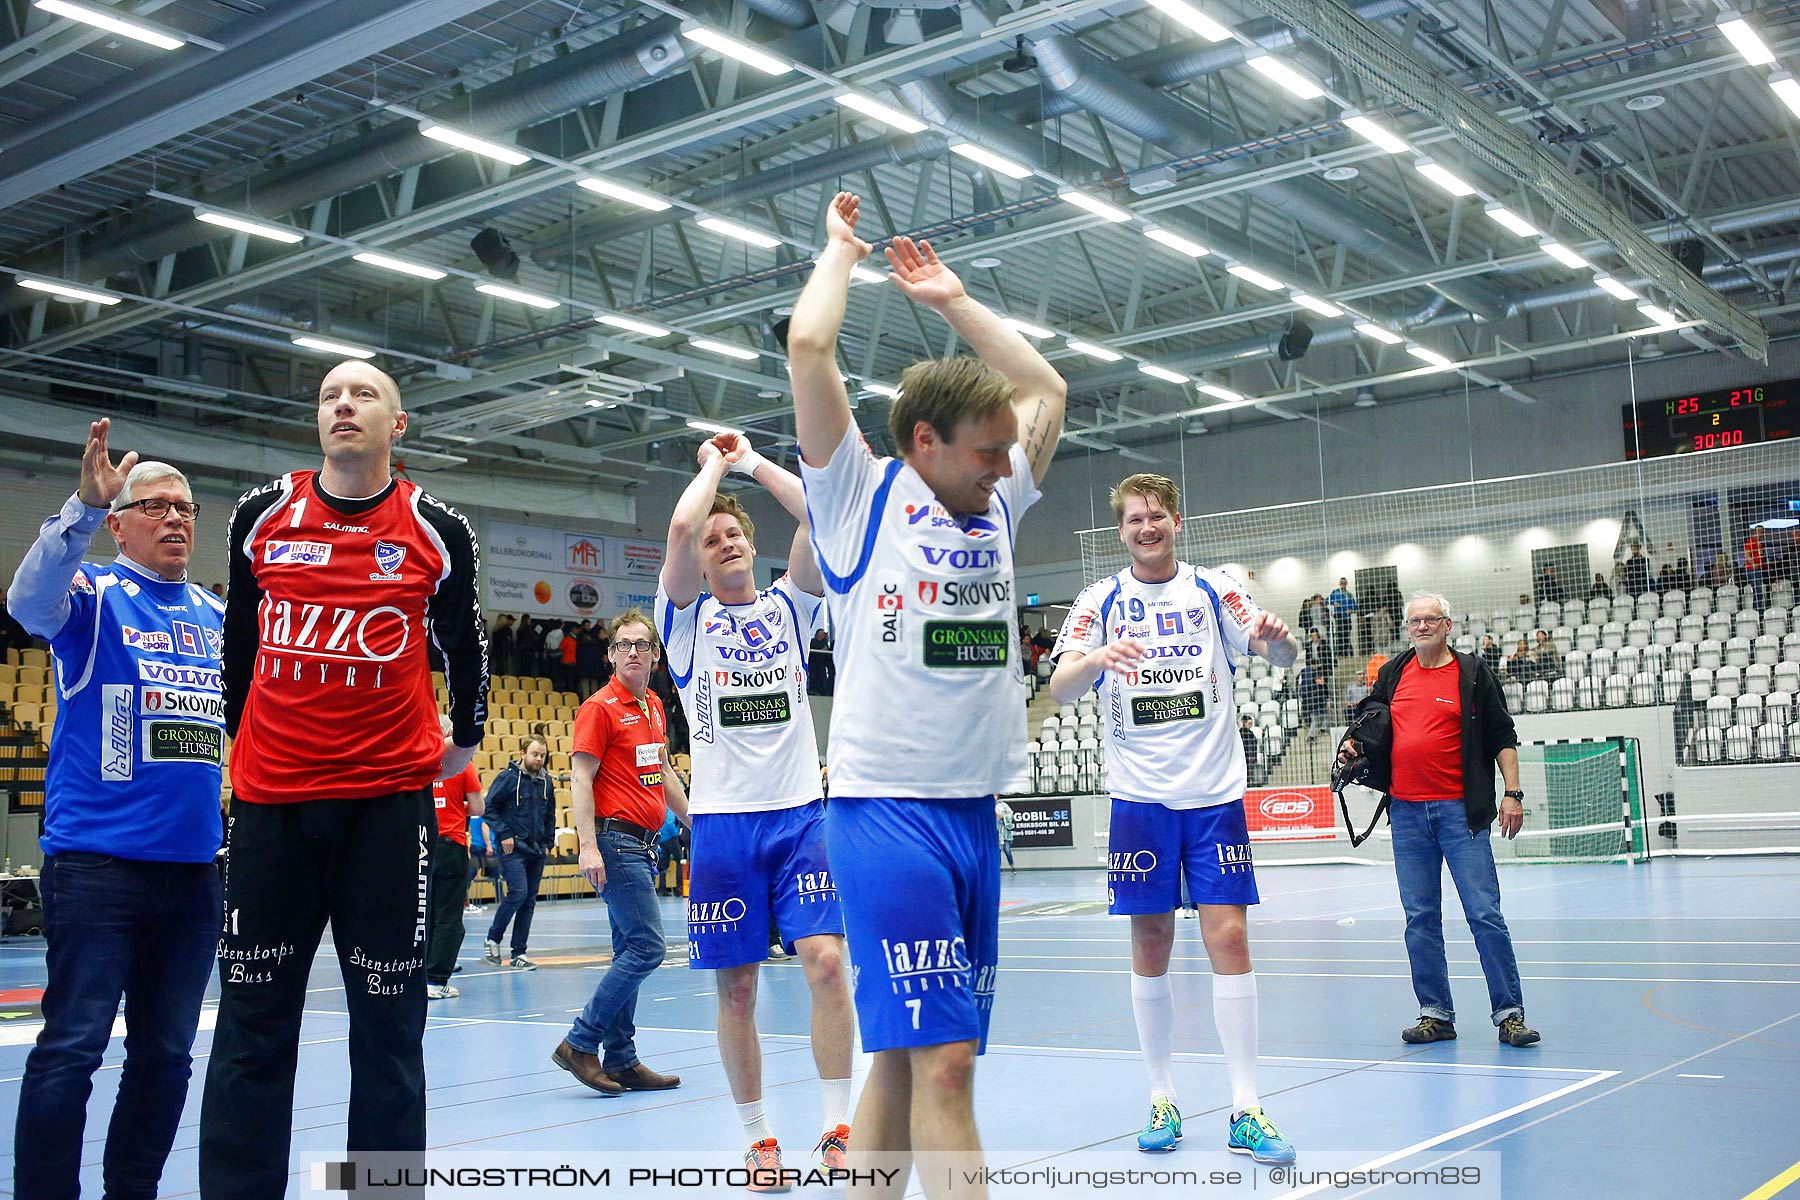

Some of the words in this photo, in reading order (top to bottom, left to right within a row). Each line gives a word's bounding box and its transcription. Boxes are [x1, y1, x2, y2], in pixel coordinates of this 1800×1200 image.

[1666, 402, 1674, 415] H
[1678, 397, 1699, 414] 25
[1730, 389, 1752, 406] 27
[1755, 387, 1764, 402] G
[1712, 413, 1720, 425] 2
[290, 498, 308, 528] 1
[290, 551, 326, 563] SPORT
[291, 543, 327, 555] INTER
[1115, 597, 1146, 622] 19
[1221, 589, 1253, 626] MAXI
[143, 640, 170, 650] SPORT
[931, 628, 1007, 645] GRÖNSAKS
[716, 640, 789, 663] VOLVO
[957, 645, 1000, 661] HUSET
[1143, 644, 1203, 660] OLVO
[1141, 666, 1204, 685] SKÖVDE
[723, 697, 786, 713] GRÖNSAKS
[1136, 694, 1198, 712] GRÖNSAKS
[741, 708, 781, 722] HUSET
[1154, 706, 1191, 721] HUSET
[157, 727, 219, 745] GRÖNSAKS
[179, 741, 215, 757] HUSET
[231, 908, 239, 935] 1
[217, 938, 295, 967] Stenstorps
[349, 946, 424, 977] Stenstorps
[227, 963, 273, 984] Buss
[367, 973, 404, 995] Buss
[905, 998, 922, 1030] 7
